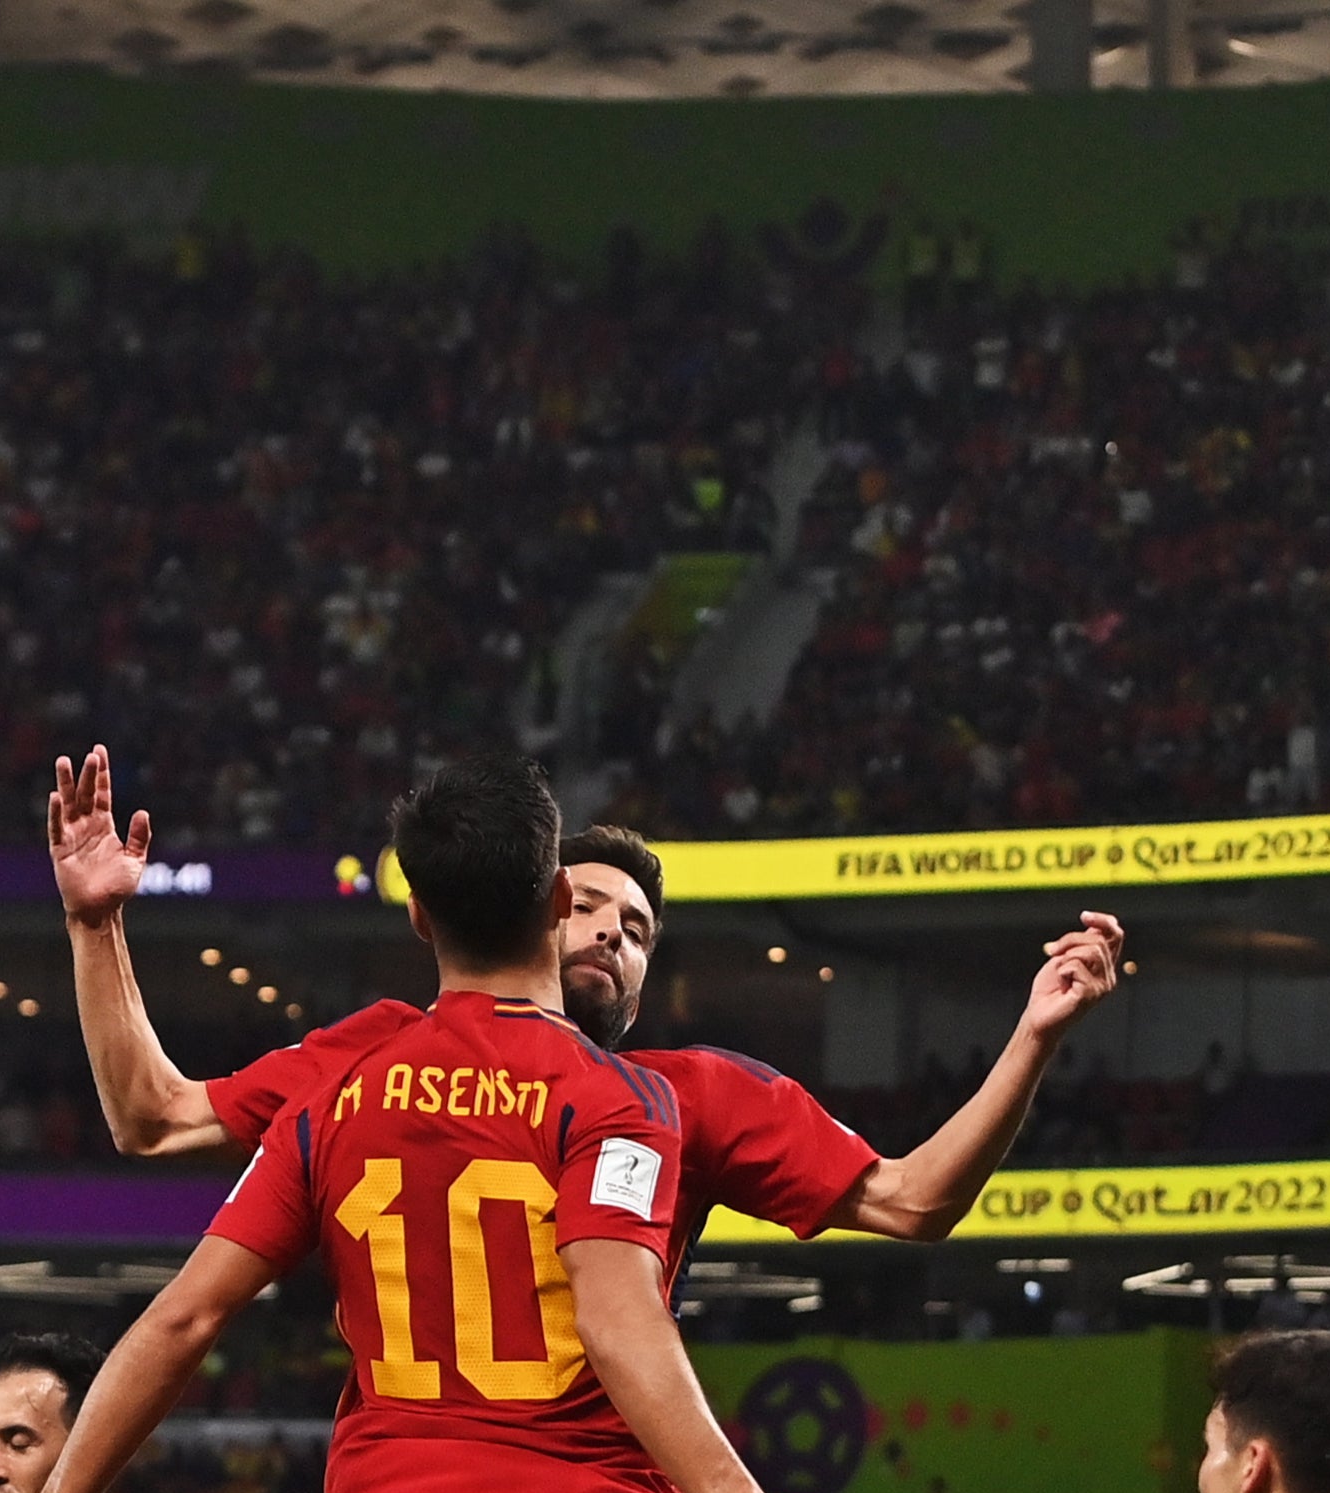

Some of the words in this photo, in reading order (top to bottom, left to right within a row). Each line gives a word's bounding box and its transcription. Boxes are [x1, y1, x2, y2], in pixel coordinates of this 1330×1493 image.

[837, 851, 903, 879] FIFA
[911, 846, 1027, 875] WORLD
[1035, 843, 1096, 871] CUP
[333, 1074, 363, 1122] M
[980, 1186, 1053, 1220] CUP
[334, 1158, 586, 1400] 10
